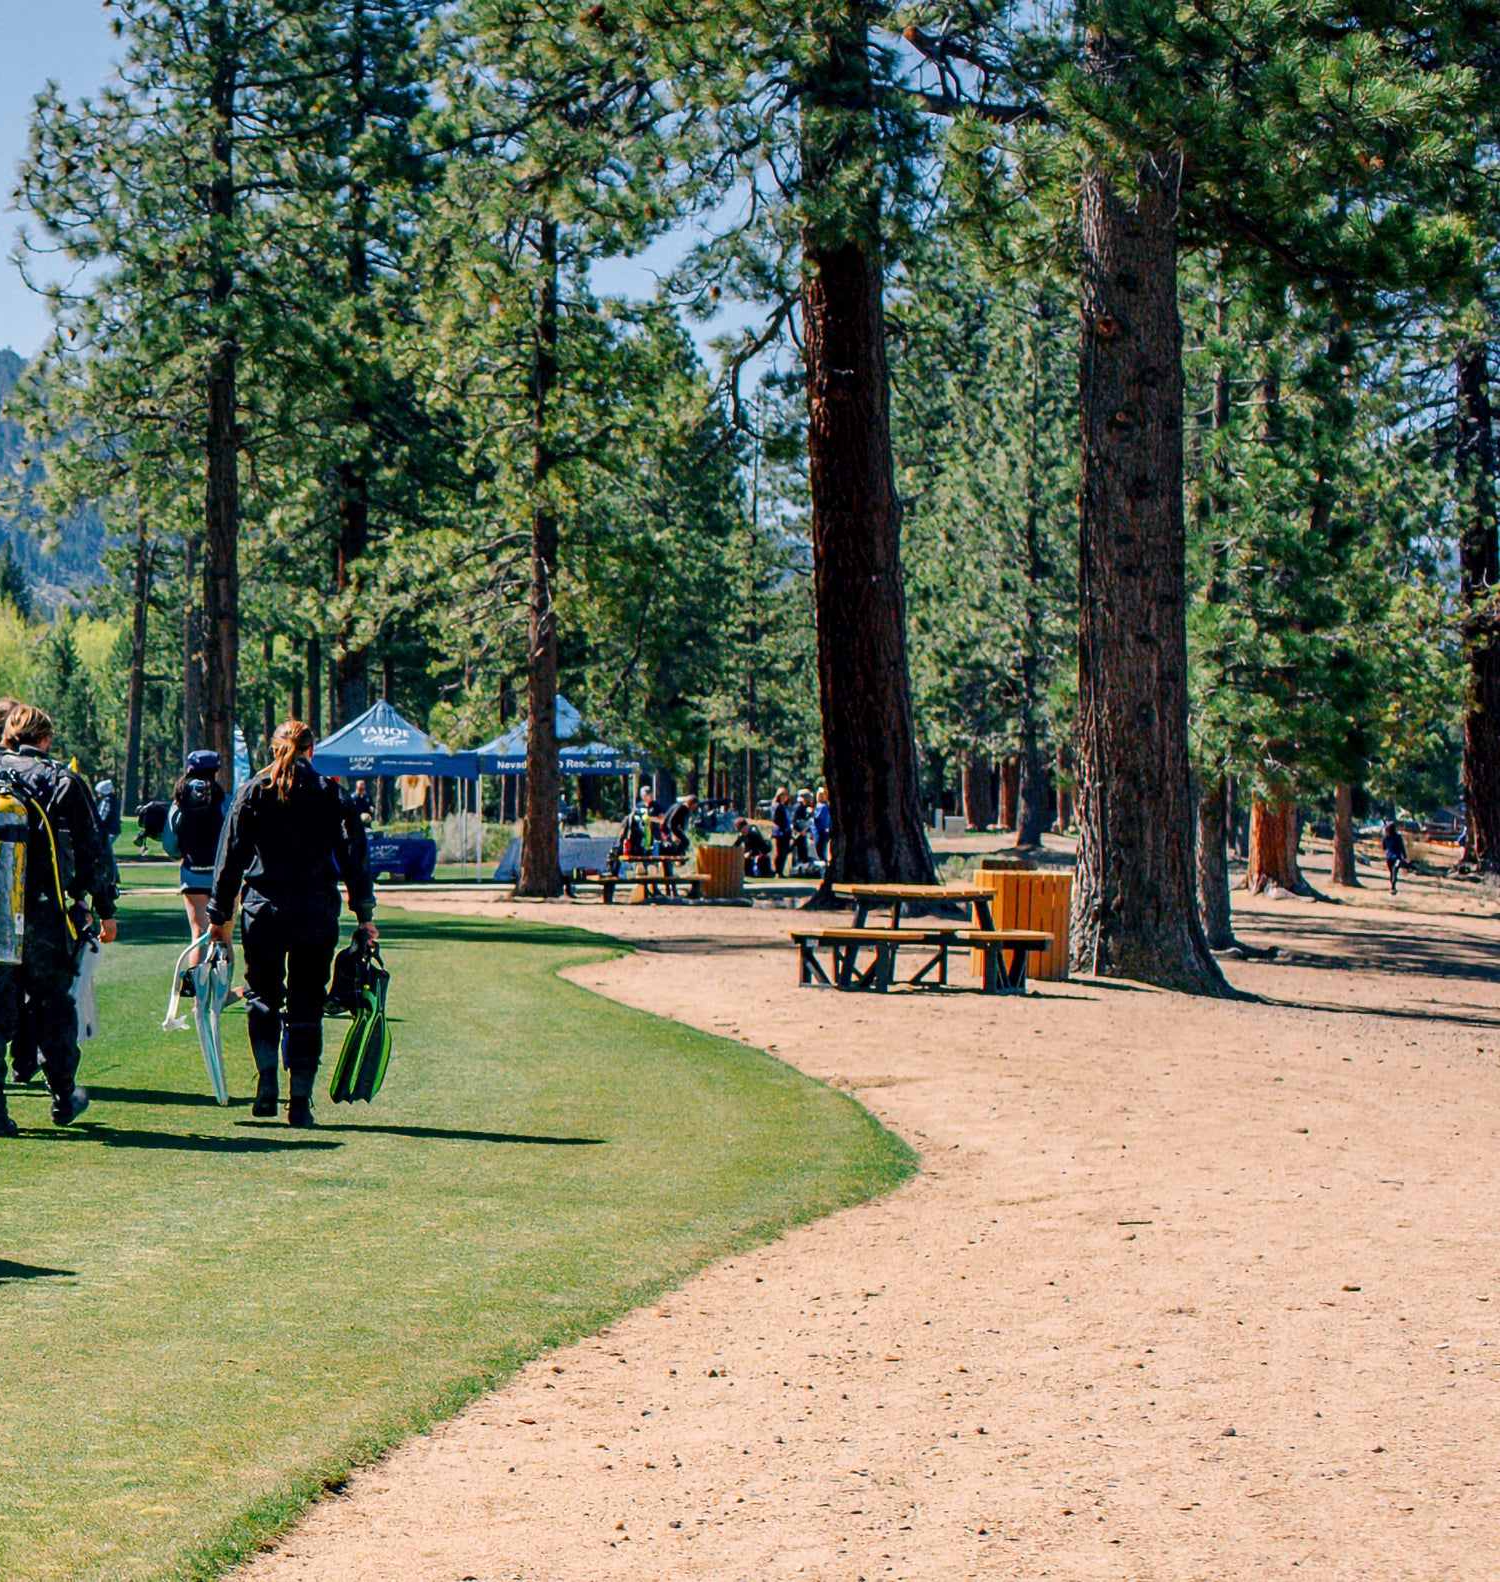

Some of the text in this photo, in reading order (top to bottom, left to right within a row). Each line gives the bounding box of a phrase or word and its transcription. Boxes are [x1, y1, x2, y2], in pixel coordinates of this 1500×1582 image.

[358, 726, 410, 738] TAHOE
[497, 760, 527, 769] Nevad
[615, 759, 640, 769] Tam
